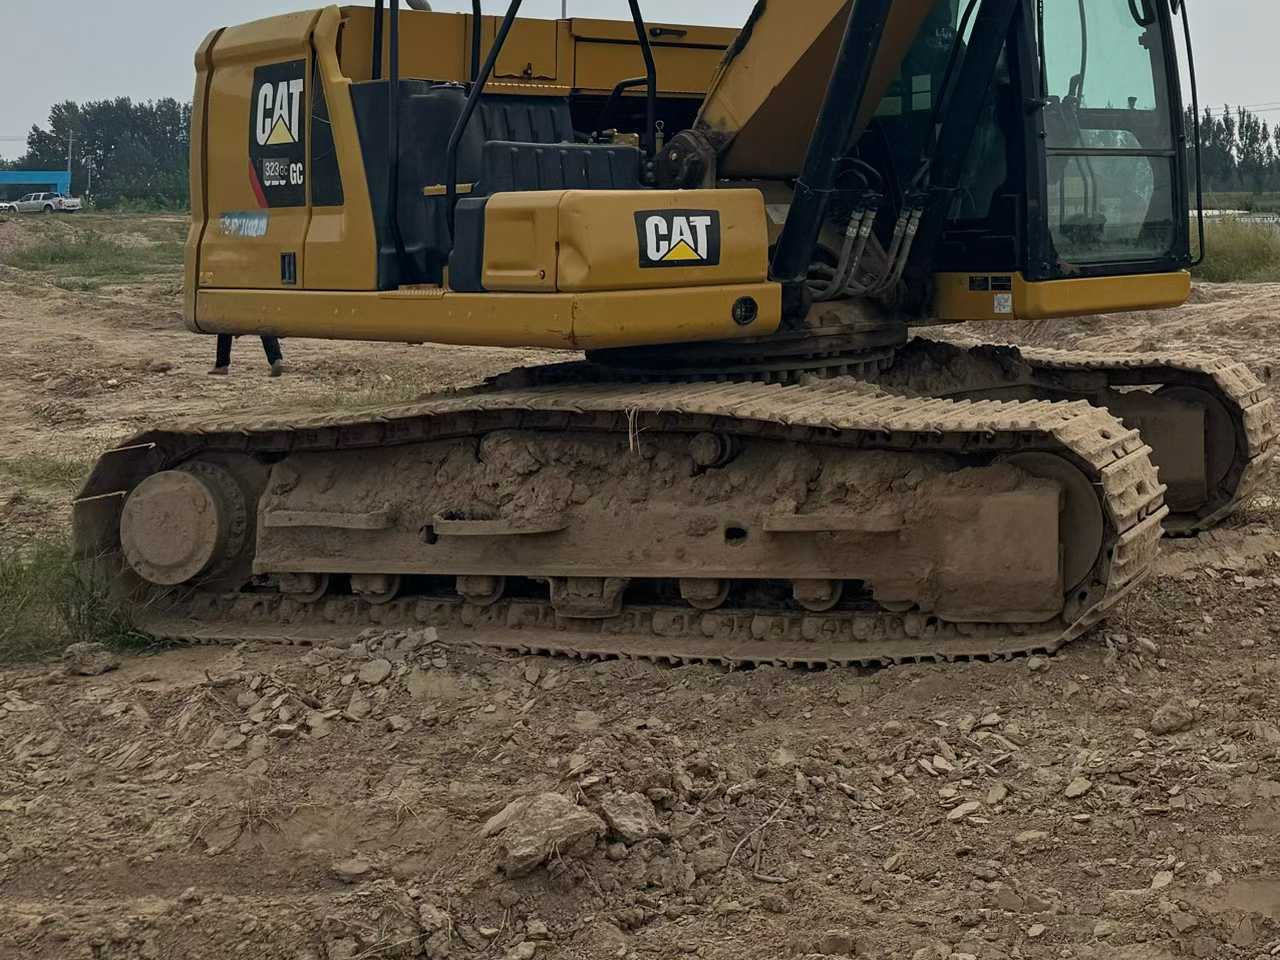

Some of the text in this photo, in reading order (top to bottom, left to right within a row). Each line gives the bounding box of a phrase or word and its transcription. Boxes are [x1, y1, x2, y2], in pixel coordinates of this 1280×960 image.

[257, 79, 304, 146] CAT
[265, 162, 280, 176] 323
[290, 163, 304, 185] GC
[645, 215, 711, 261] CAT
